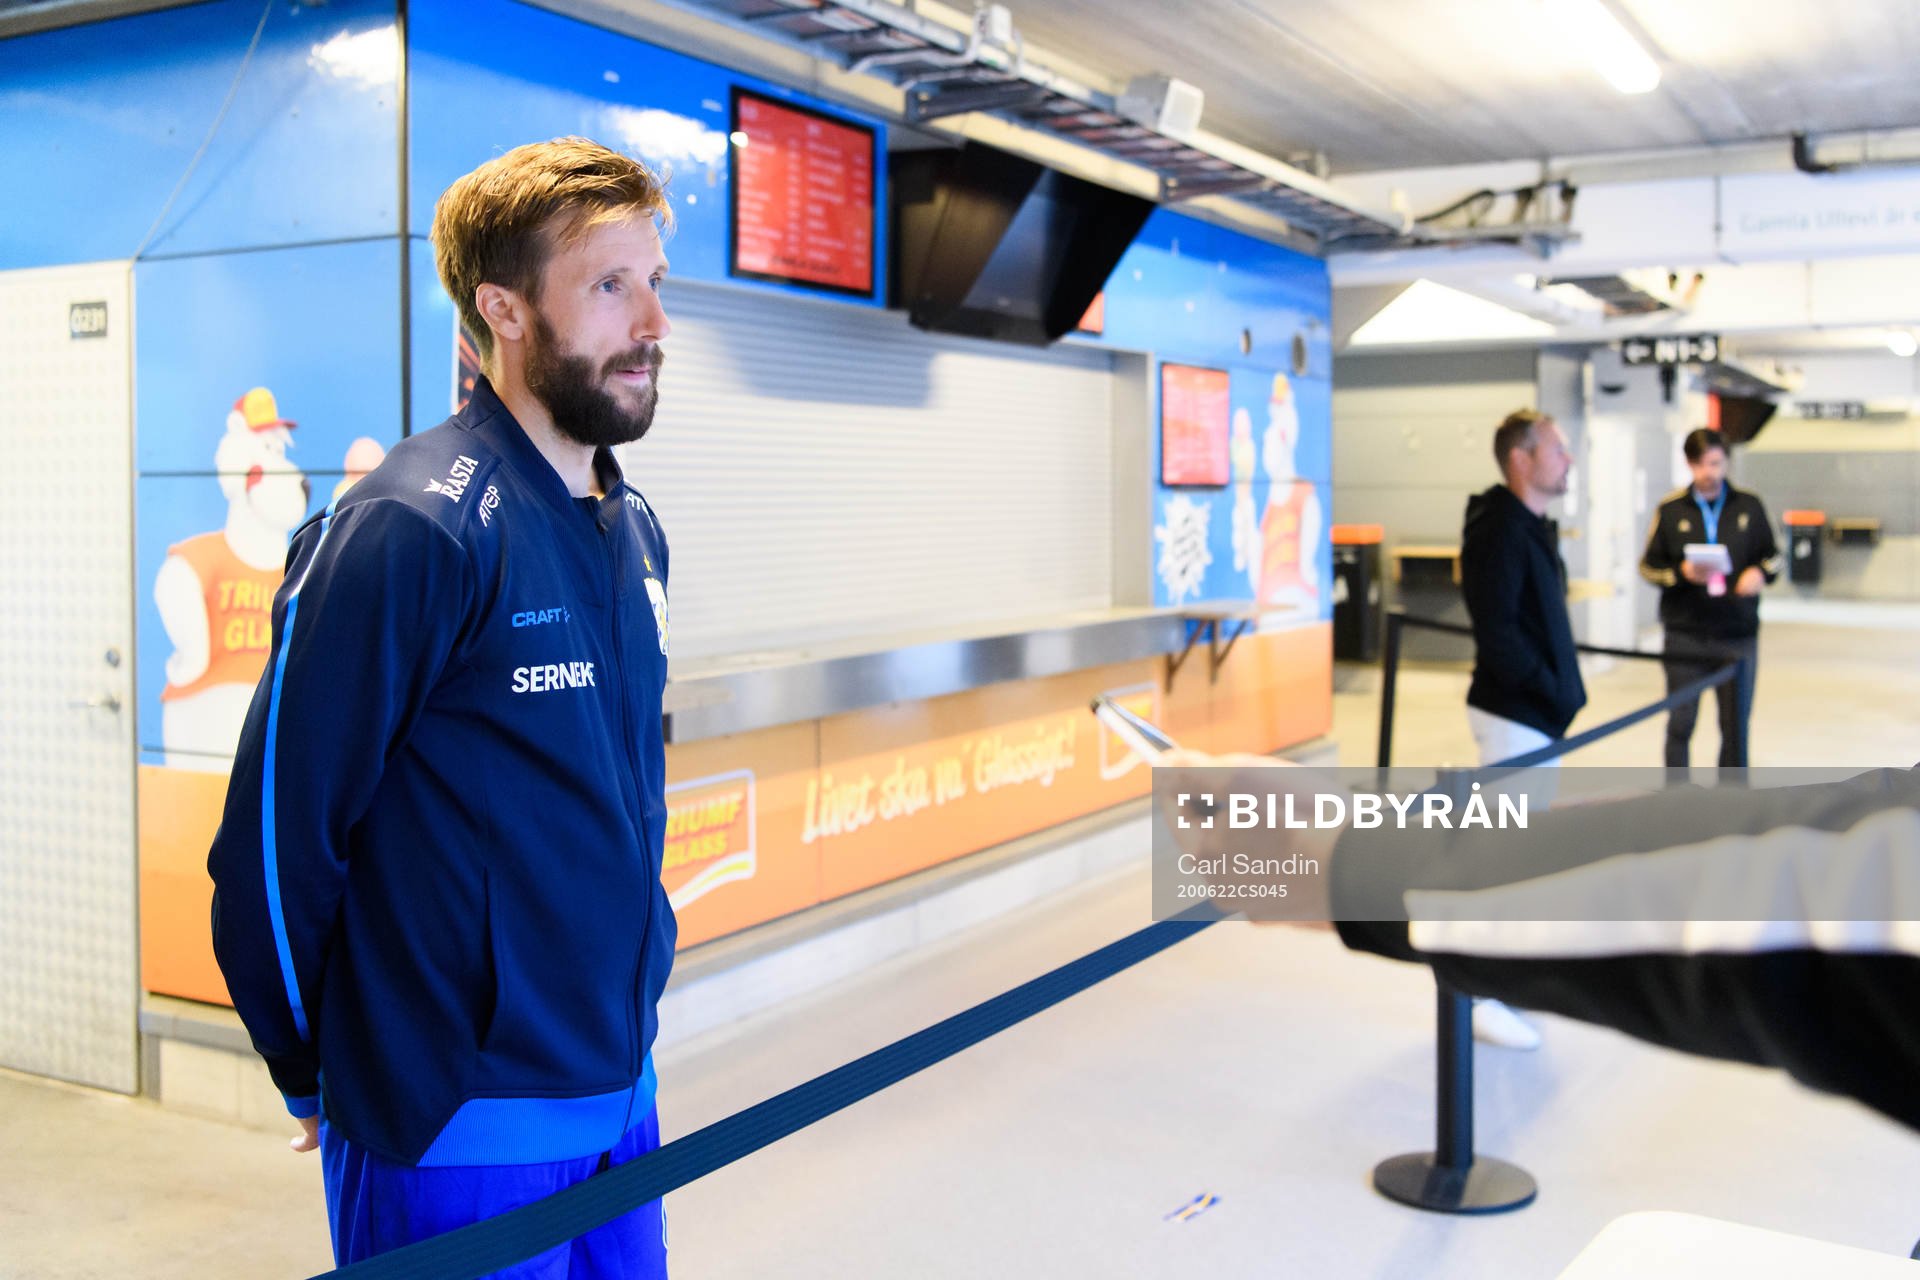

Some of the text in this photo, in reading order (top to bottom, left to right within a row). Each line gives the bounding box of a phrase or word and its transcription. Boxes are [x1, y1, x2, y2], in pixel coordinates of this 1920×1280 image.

[1654, 337, 1718, 364] N1-3
[439, 454, 479, 503] RASTA
[511, 607, 562, 628] CRAFT
[801, 771, 876, 843] Livet
[879, 755, 932, 820] ska
